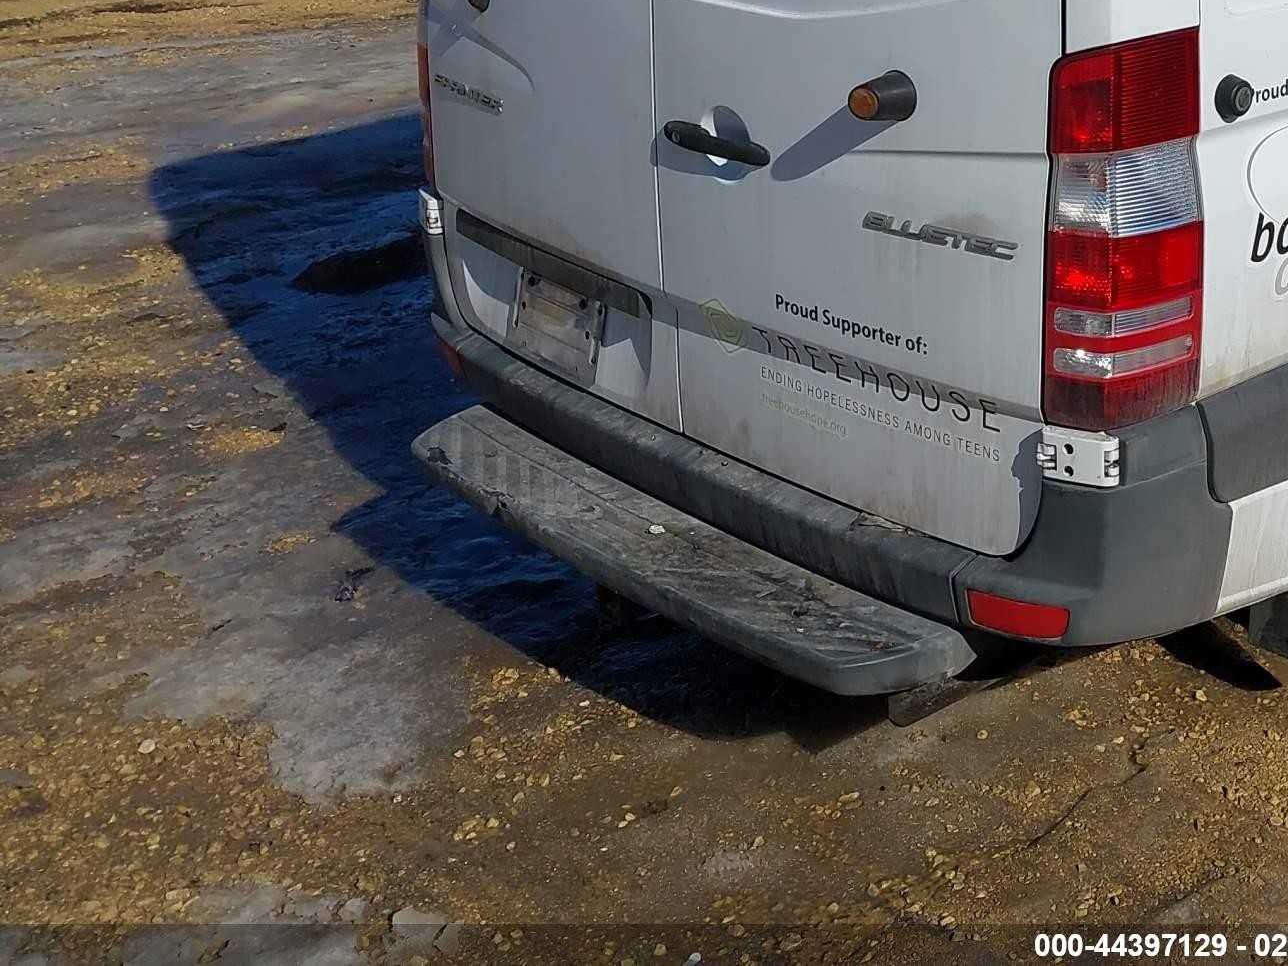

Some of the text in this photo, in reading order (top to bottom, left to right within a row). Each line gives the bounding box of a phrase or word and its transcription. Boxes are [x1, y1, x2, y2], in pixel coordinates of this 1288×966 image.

[1251, 80, 1288, 104] roud
[861, 210, 1019, 261] BLUETEC
[775, 293, 929, 356] Proud Supporter of:
[752, 326, 1001, 433] TREEHOUSE
[761, 365, 1001, 462] ENDING HOPELESSNESS AMONG TEENS
